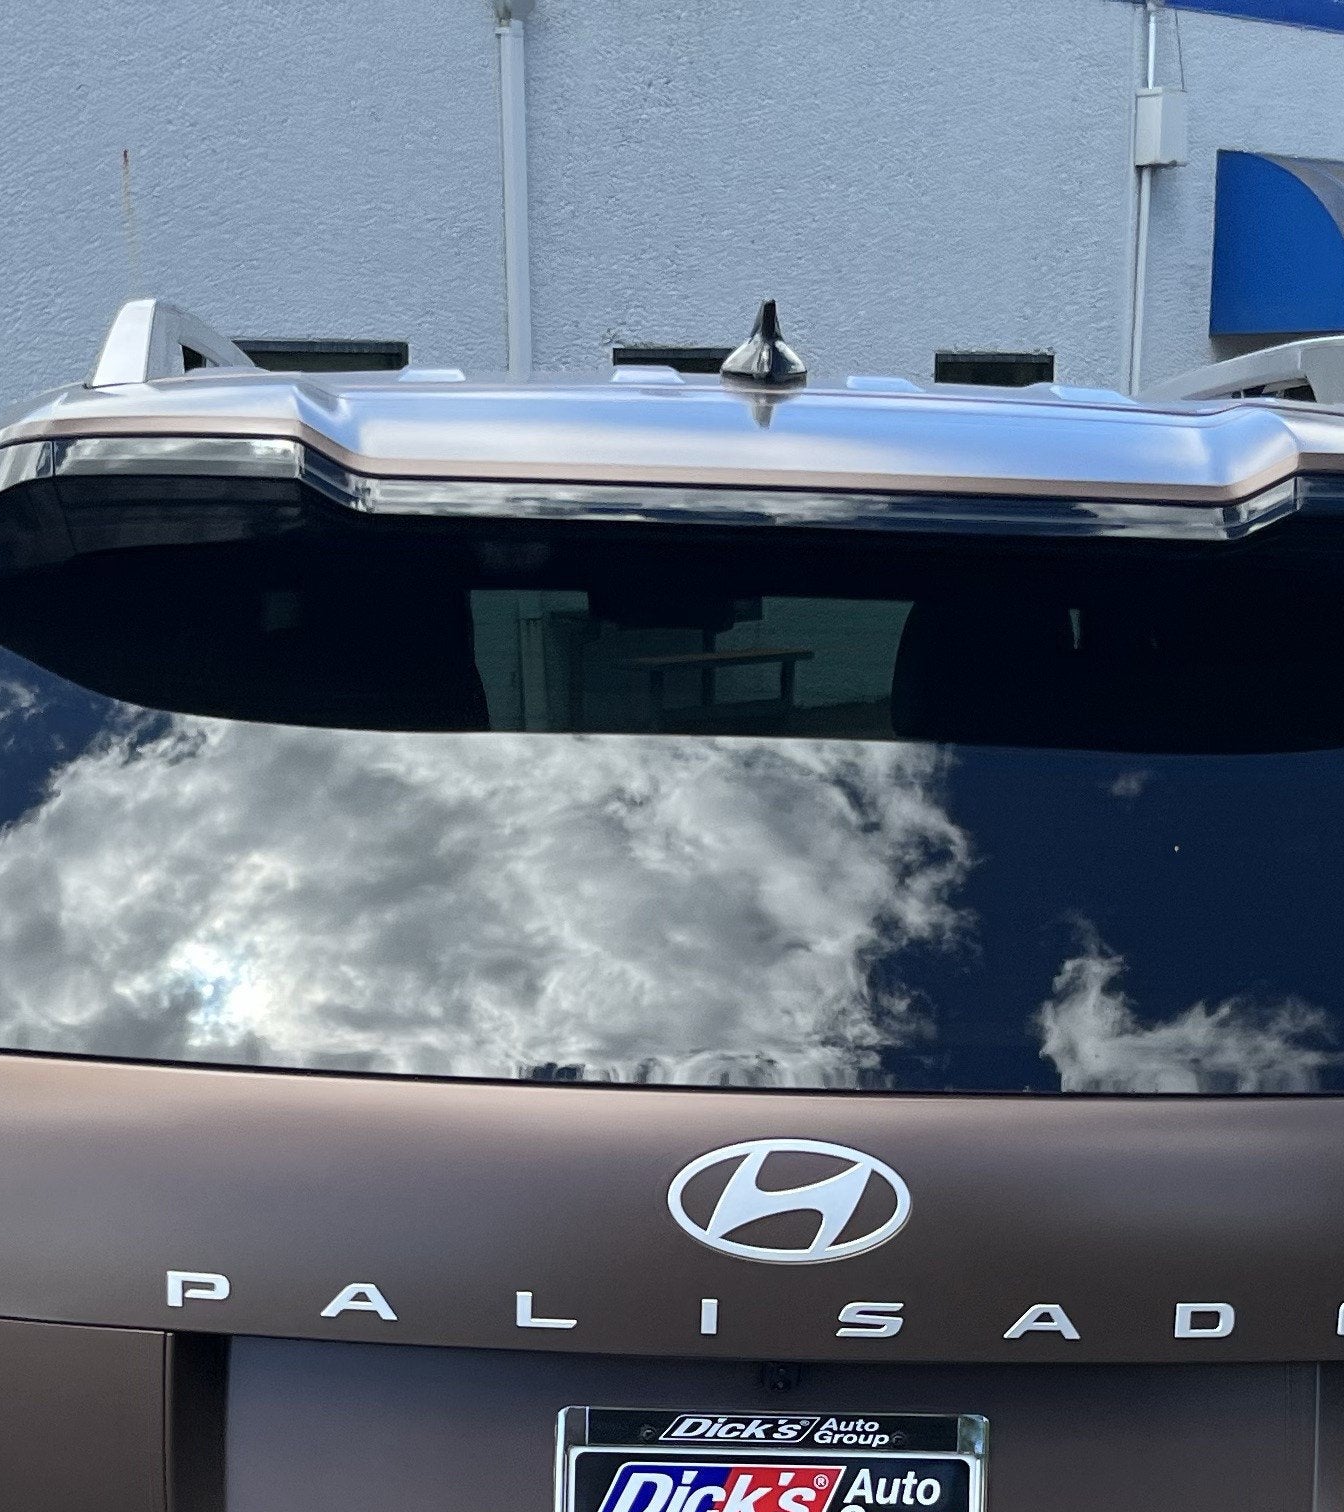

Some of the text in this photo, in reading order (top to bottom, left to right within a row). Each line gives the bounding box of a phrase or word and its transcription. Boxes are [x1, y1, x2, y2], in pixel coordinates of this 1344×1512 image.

[819, 1417, 879, 1432] Auto
[813, 1430, 890, 1448] Group
[843, 1468, 941, 1506] Auto
